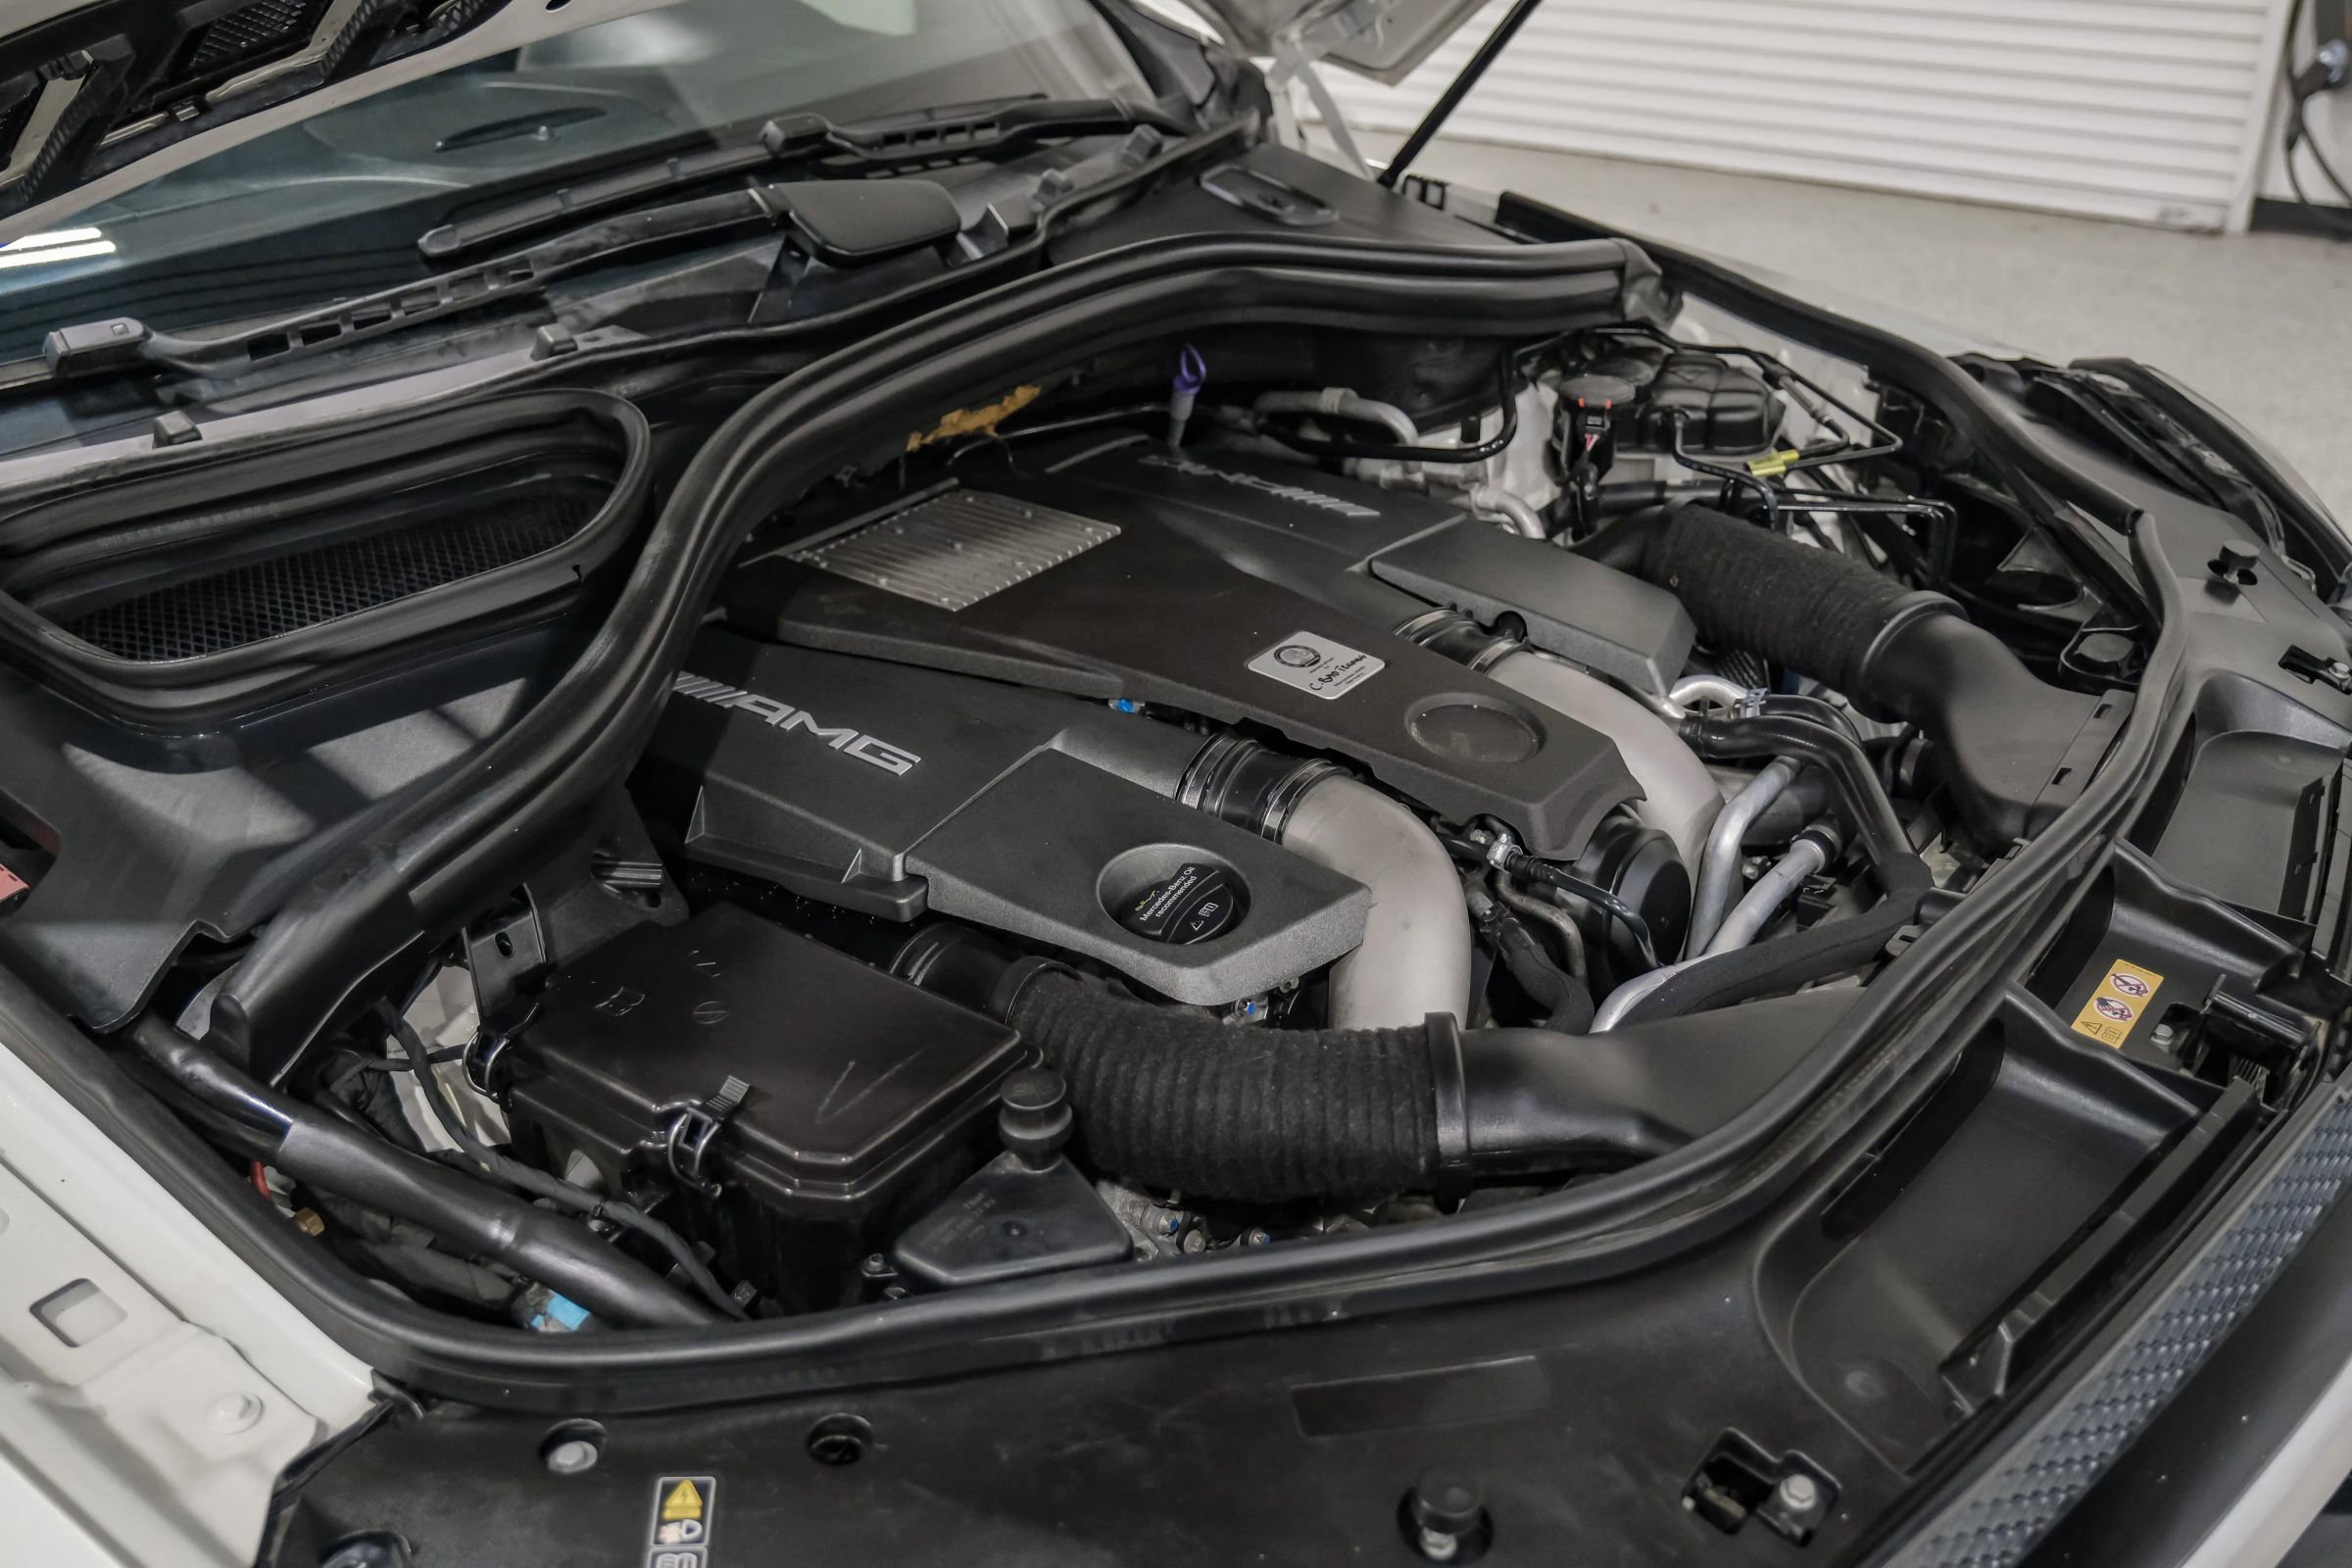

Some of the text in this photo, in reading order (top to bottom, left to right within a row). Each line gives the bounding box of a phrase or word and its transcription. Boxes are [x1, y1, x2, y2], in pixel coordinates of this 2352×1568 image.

[729, 692, 922, 776] AMG
[1140, 866, 1196, 921] Mercedes-Benz Oil
[1155, 876, 1197, 917] recommended
